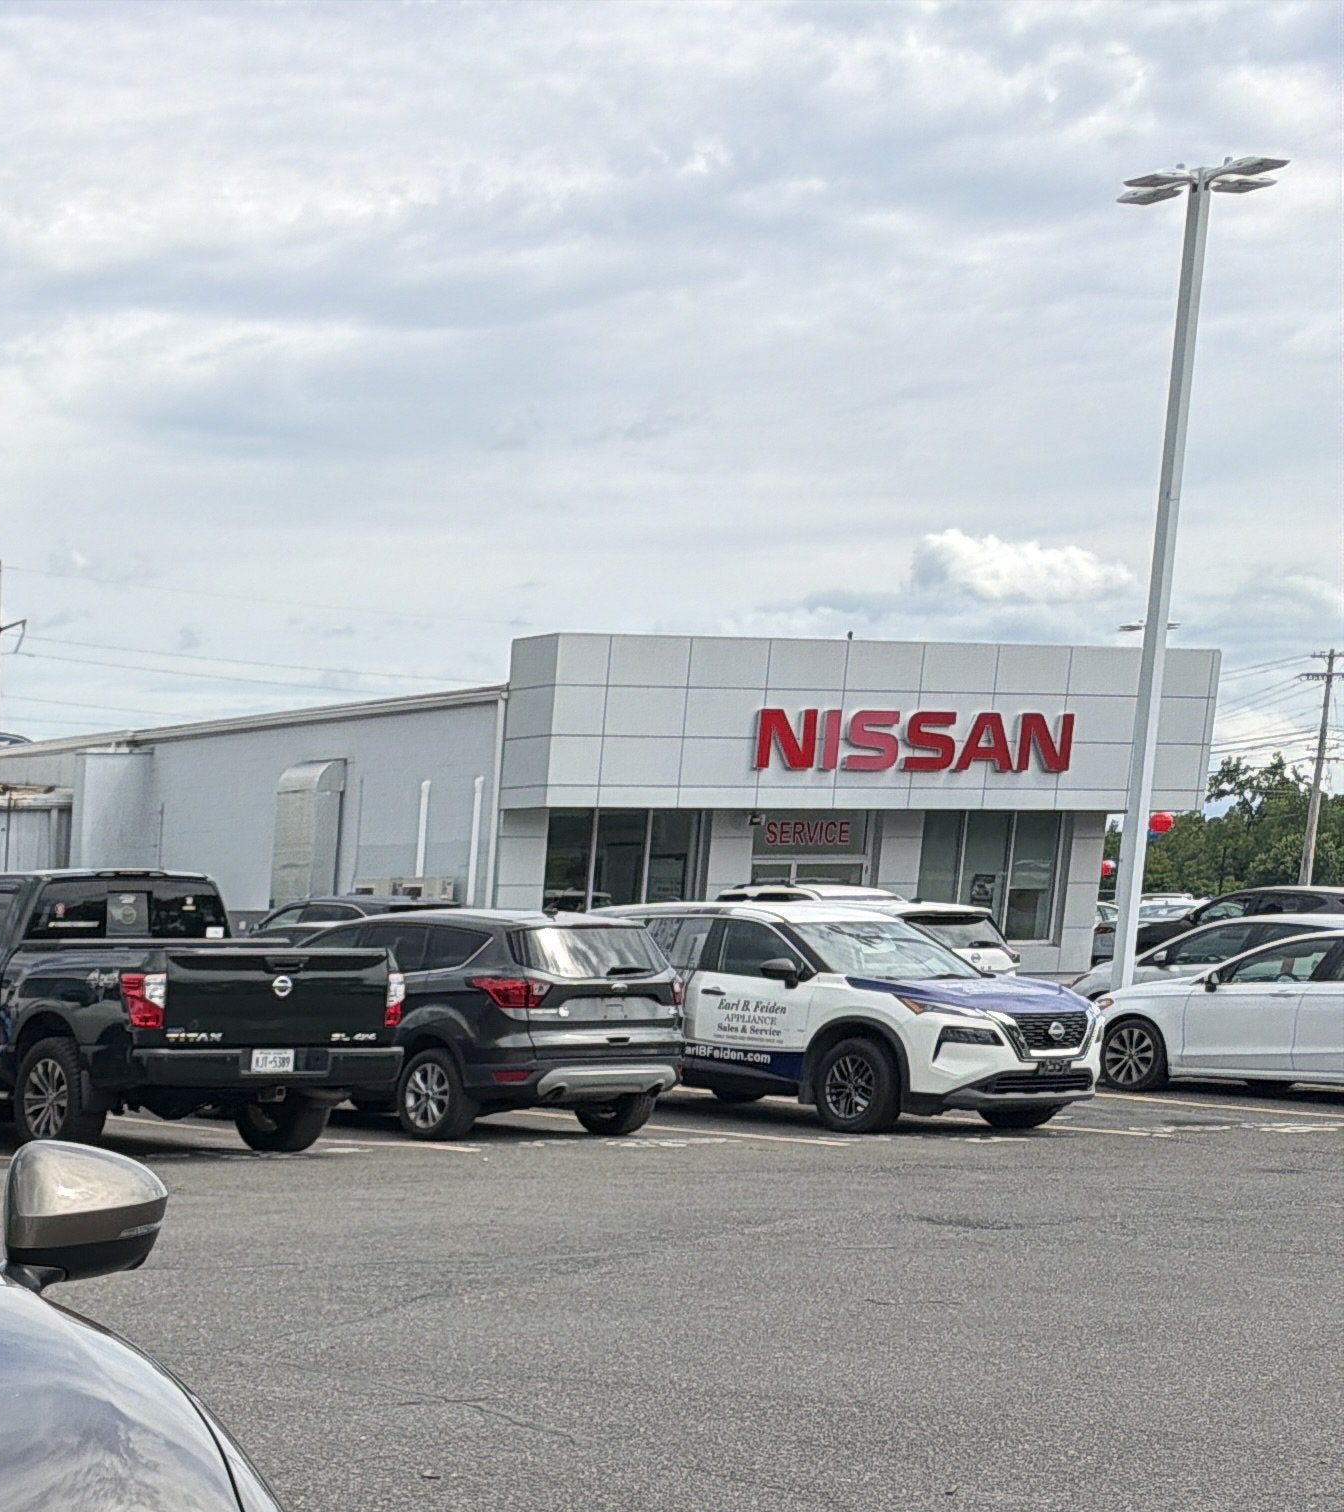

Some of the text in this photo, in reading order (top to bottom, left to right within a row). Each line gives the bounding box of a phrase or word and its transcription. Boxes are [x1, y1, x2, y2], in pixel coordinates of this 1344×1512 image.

[754, 708, 1075, 772] NISSAN
[765, 821, 851, 845] SERVICE
[717, 998, 741, 1011] Earl
[724, 1013, 777, 1026] APPLIANCE
[717, 1022, 739, 1033] Sales
[165, 1032, 224, 1042] TITAN
[684, 1045, 771, 1064] arlBFeiden.com
